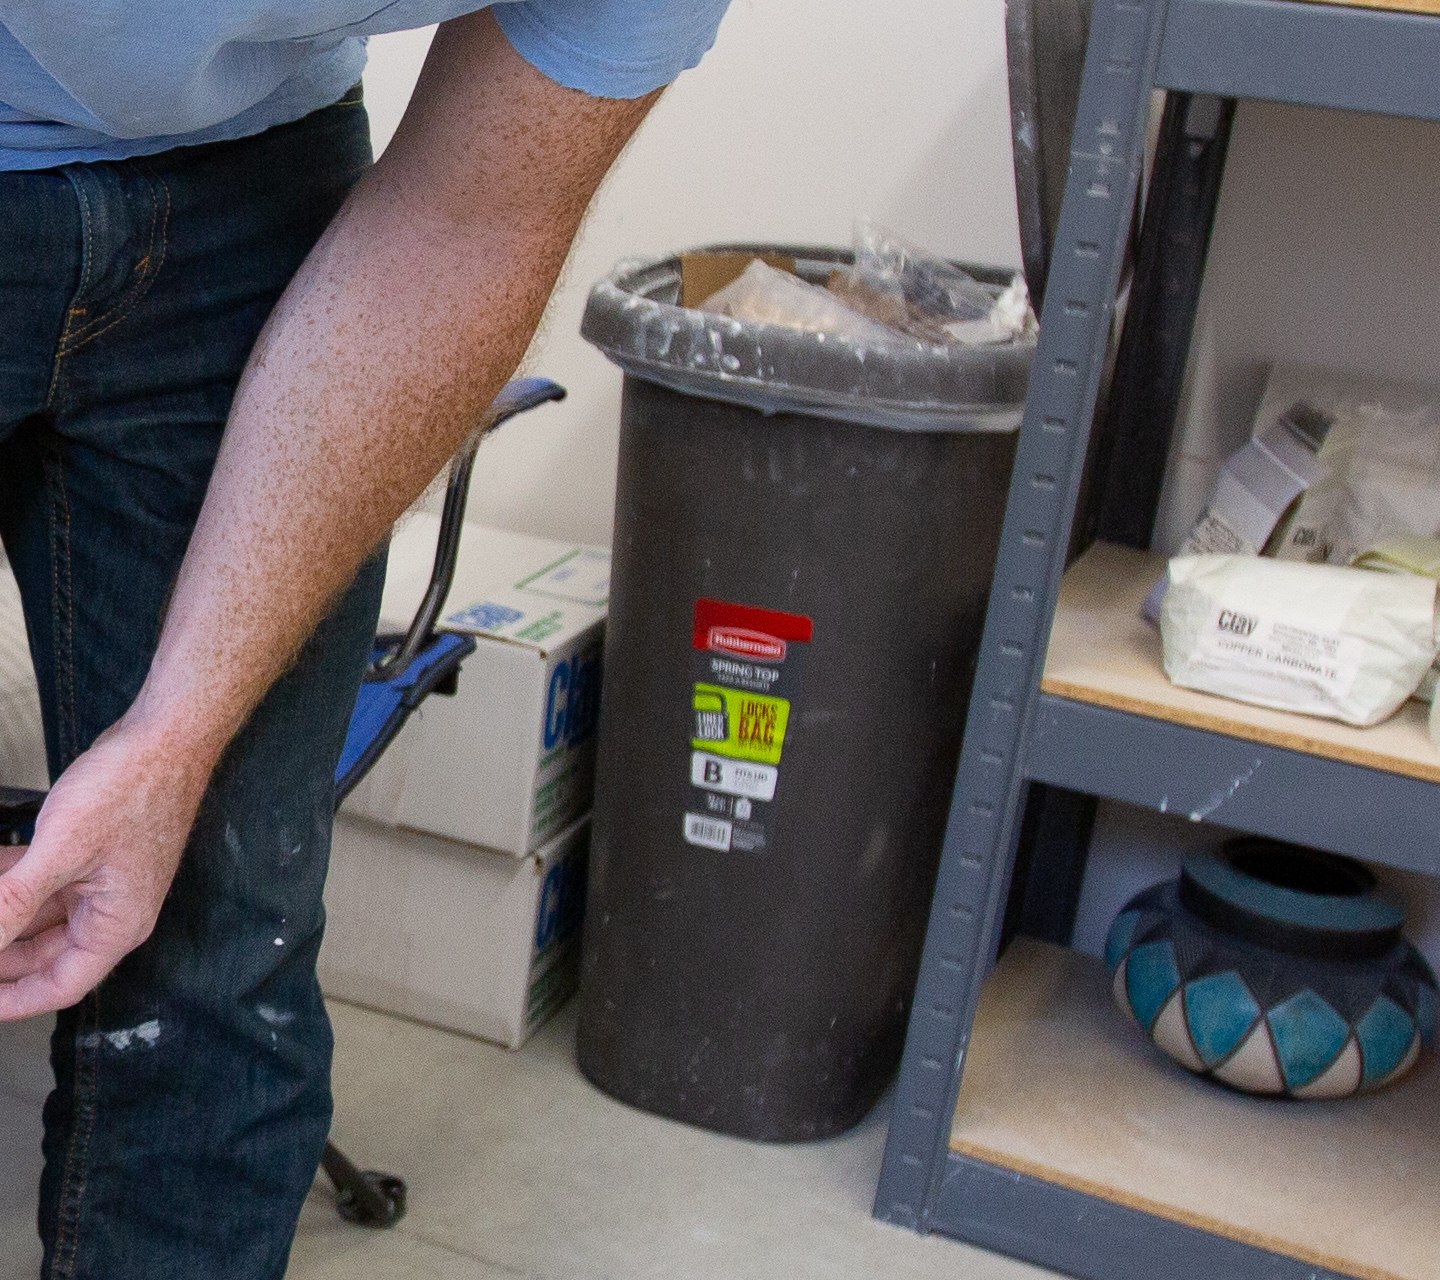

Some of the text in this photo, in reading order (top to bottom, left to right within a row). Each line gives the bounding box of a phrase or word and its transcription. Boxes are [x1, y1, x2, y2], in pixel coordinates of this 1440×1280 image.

[711, 658, 780, 682] SPRING TOP
[740, 699, 778, 722] LOCKS
[737, 716, 775, 746] BAG
[704, 760, 722, 784] B
